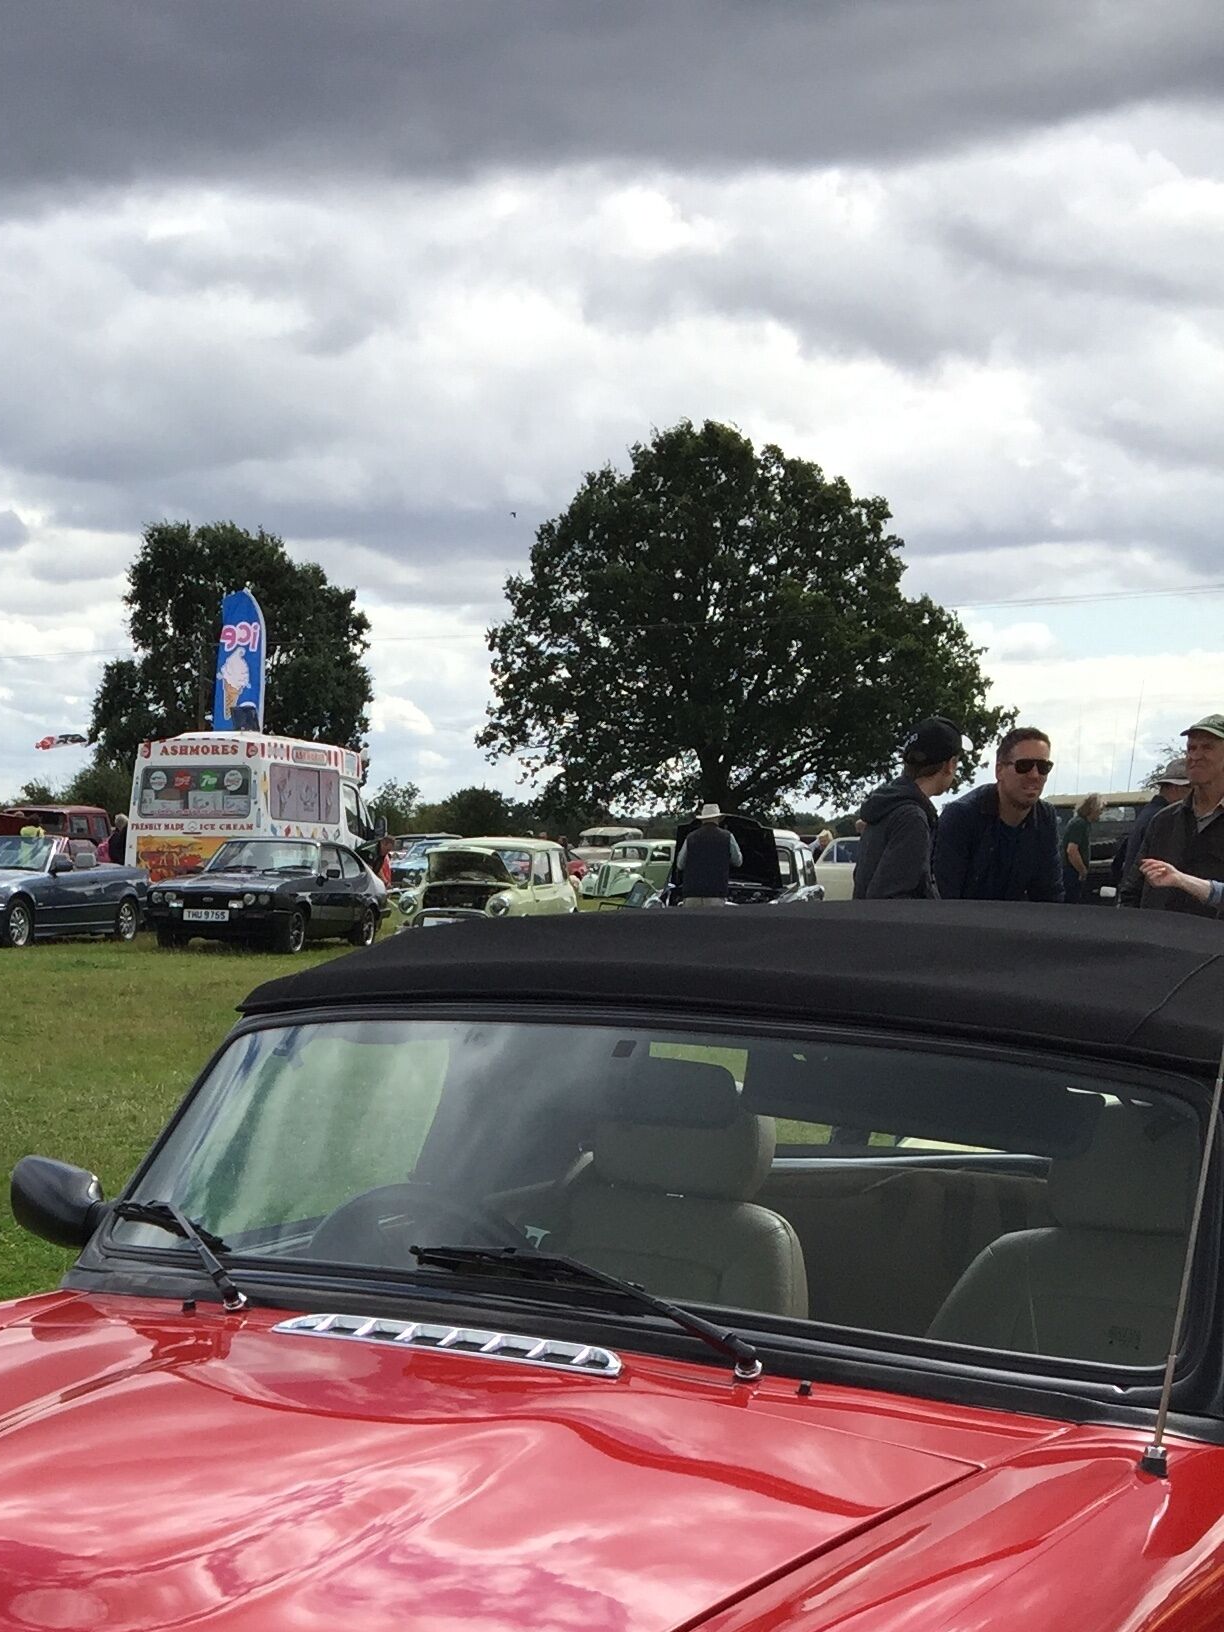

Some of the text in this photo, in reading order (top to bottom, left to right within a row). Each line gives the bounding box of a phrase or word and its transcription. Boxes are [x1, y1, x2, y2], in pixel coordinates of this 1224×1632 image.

[160, 744, 239, 756] ASHMORES
[164, 823, 185, 831] MADE
[199, 823, 216, 831] ICE
[219, 823, 254, 831] CREAM
